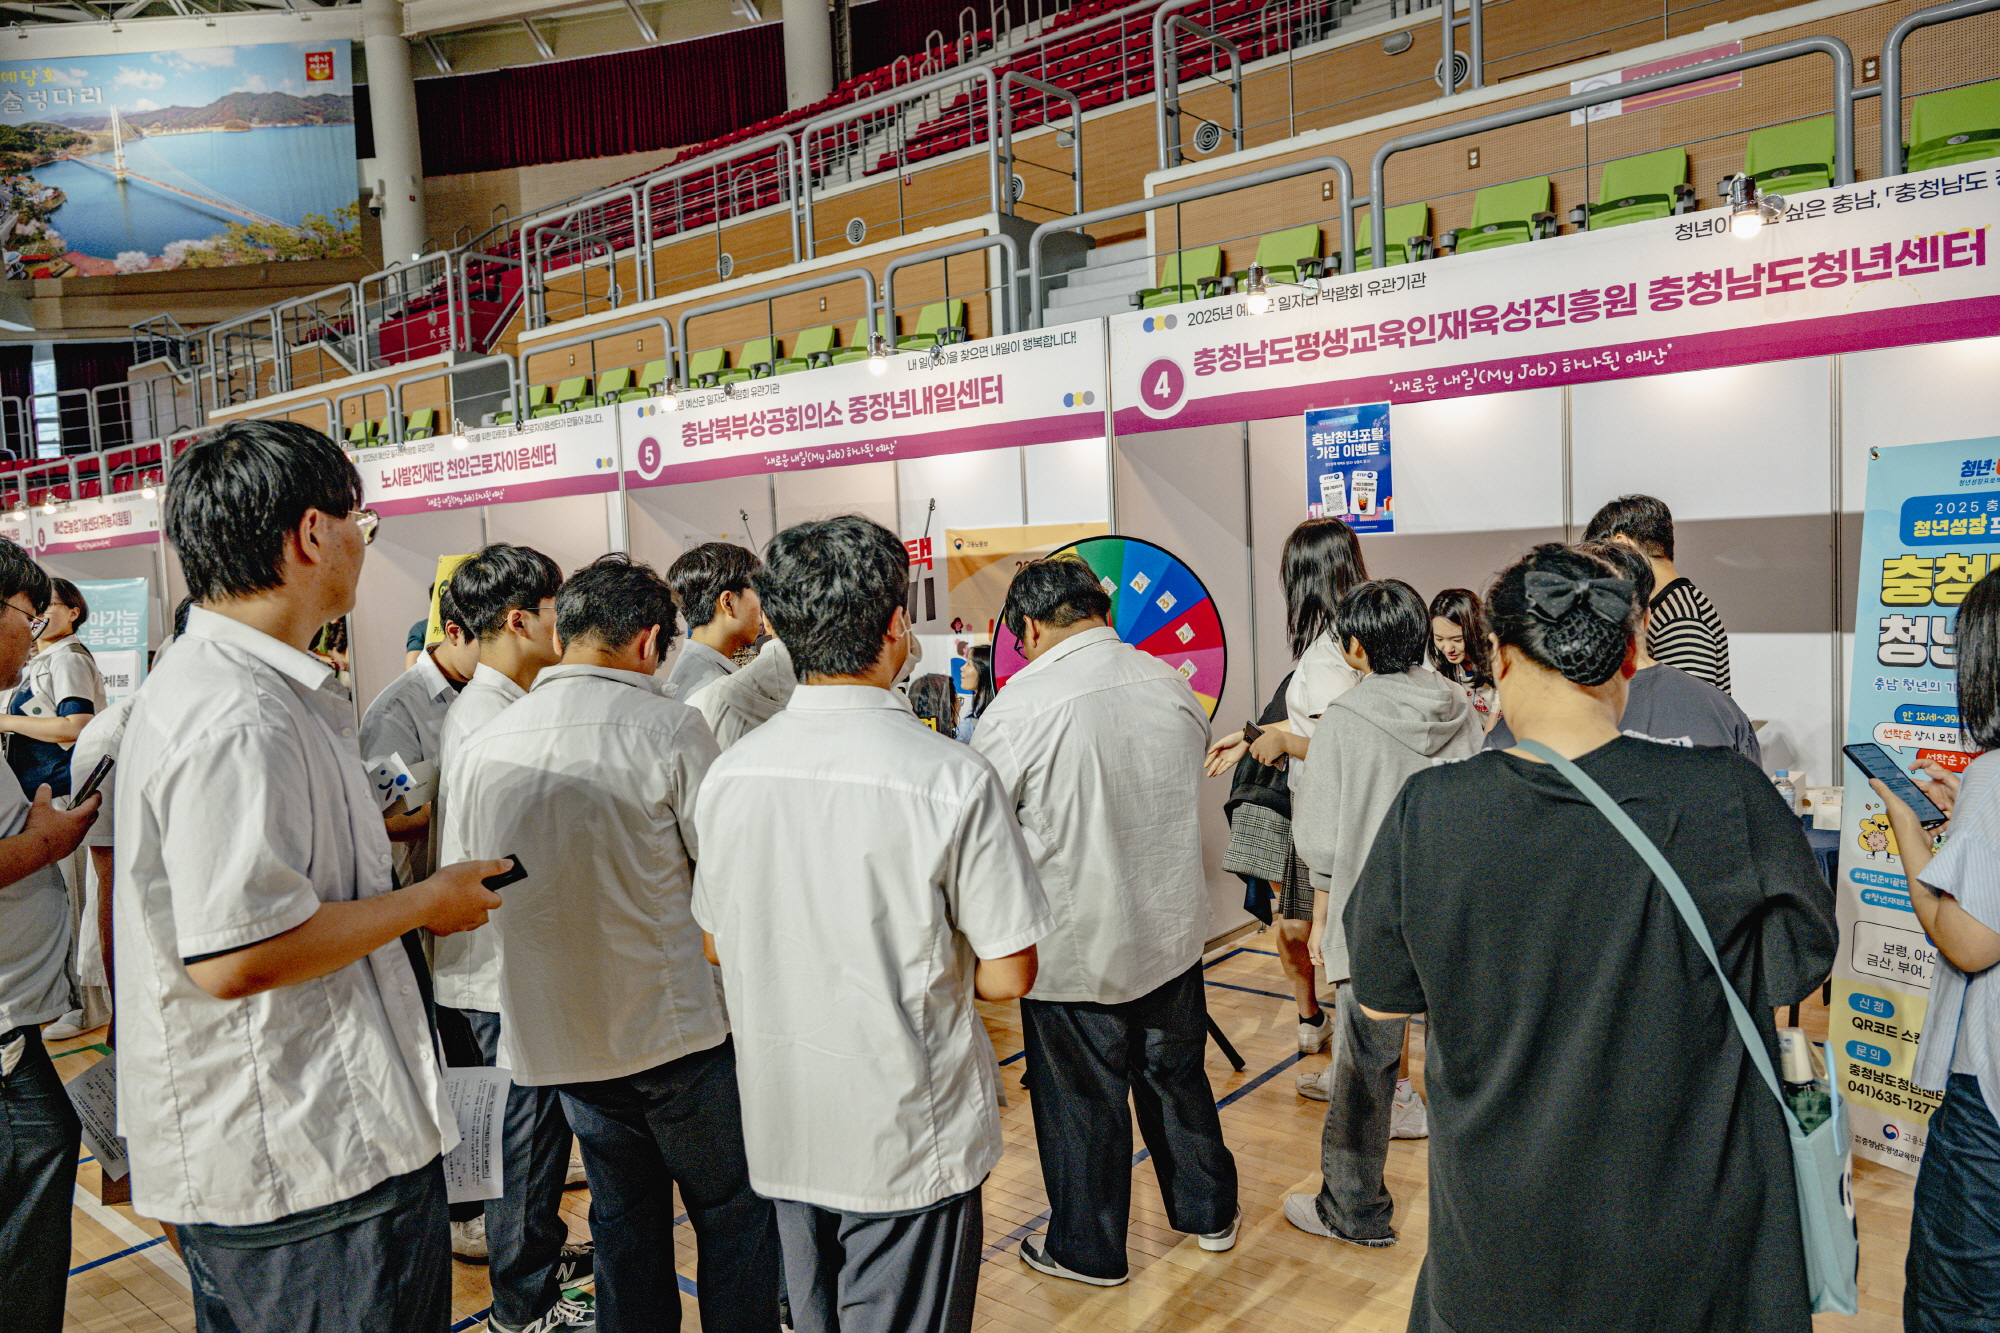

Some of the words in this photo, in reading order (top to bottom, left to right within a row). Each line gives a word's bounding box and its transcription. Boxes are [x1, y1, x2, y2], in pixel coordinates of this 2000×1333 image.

[0, 67, 57, 87] 예당호
[1675, 215, 1732, 241] 청년이
[1785, 199, 1827, 223] 싶은
[1832, 189, 1882, 214] 충남,
[1187, 304, 1233, 327] 2025년
[1236, 297, 1275, 318] 예군
[1321, 283, 1363, 304] 박람회
[1366, 272, 1427, 298] 유관기관
[1193, 283, 1638, 376] 충청남도평생교육인재육성진흥원
[1648, 228, 1986, 312] 충청남도청년센터
[907, 358, 917, 371] 내
[960, 346, 989, 362] 찾으면
[990, 339, 1020, 357] 내일이
[1022, 331, 1077, 351] 행복합니다!
[1517, 361, 1557, 380] Job)
[1562, 350, 1620, 373] 하나된
[751, 383, 780, 397] 유관기관
[1153, 371, 1171, 398] 4
[681, 403, 844, 448] 충남북부상공회의소
[848, 374, 1004, 425] 중장년내일센터
[1312, 428, 1383, 446] 충남청년포털
[645, 445, 654, 465] 5
[847, 443, 874, 457] 하나된
[1316, 445, 1339, 459] 가입
[1343, 443, 1380, 457] 이벤트
[381, 460, 444, 489] 노사발전재단
[446, 443, 557, 480] 천안근로자이음센터
[1935, 501, 1979, 514] 2025
[1913, 513, 1988, 537] 청년성장
[1133, 581, 1144, 591] 2
[1880, 553, 2000, 607] 충청
[1159, 598, 1169, 609] 3
[80, 610, 139, 627] 아가는
[1873, 676, 1899, 692] 충남
[1902, 678, 1941, 693] 청년의
[1902, 711, 1913, 722] 만
[1883, 728, 1912, 741] 선착순
[1914, 730, 1935, 742] 상시
[1938, 733, 1957, 745] 모집
[1883, 942, 1910, 960] 보령,
[1867, 953, 1894, 972] 금산,
[1898, 960, 1926, 979] 부여,
[1852, 1016, 1898, 1039] QR코드
